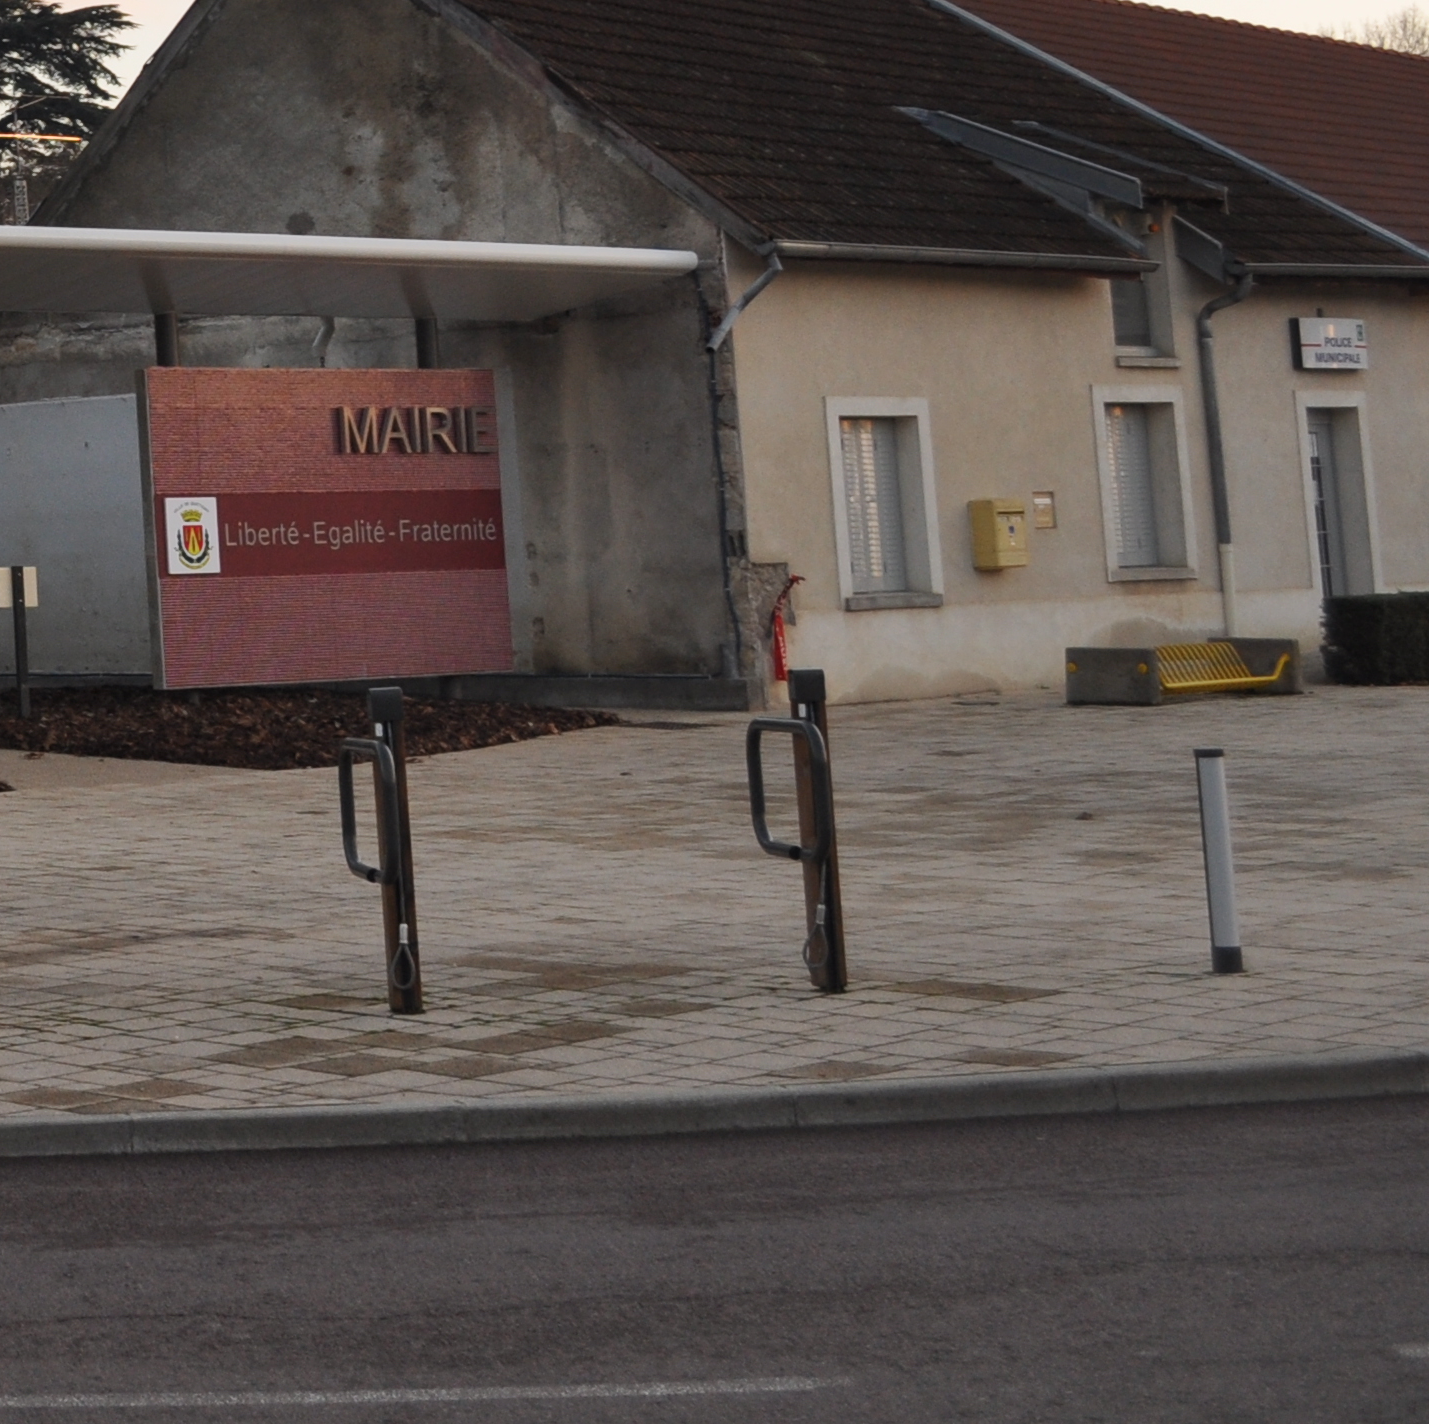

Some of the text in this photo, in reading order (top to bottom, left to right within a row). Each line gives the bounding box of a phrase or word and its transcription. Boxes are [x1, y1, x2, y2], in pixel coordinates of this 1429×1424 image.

[1324, 336, 1353, 348] POLICE
[1314, 351, 1361, 364] MUNICIPALE
[340, 405, 498, 454] MAIRIE
